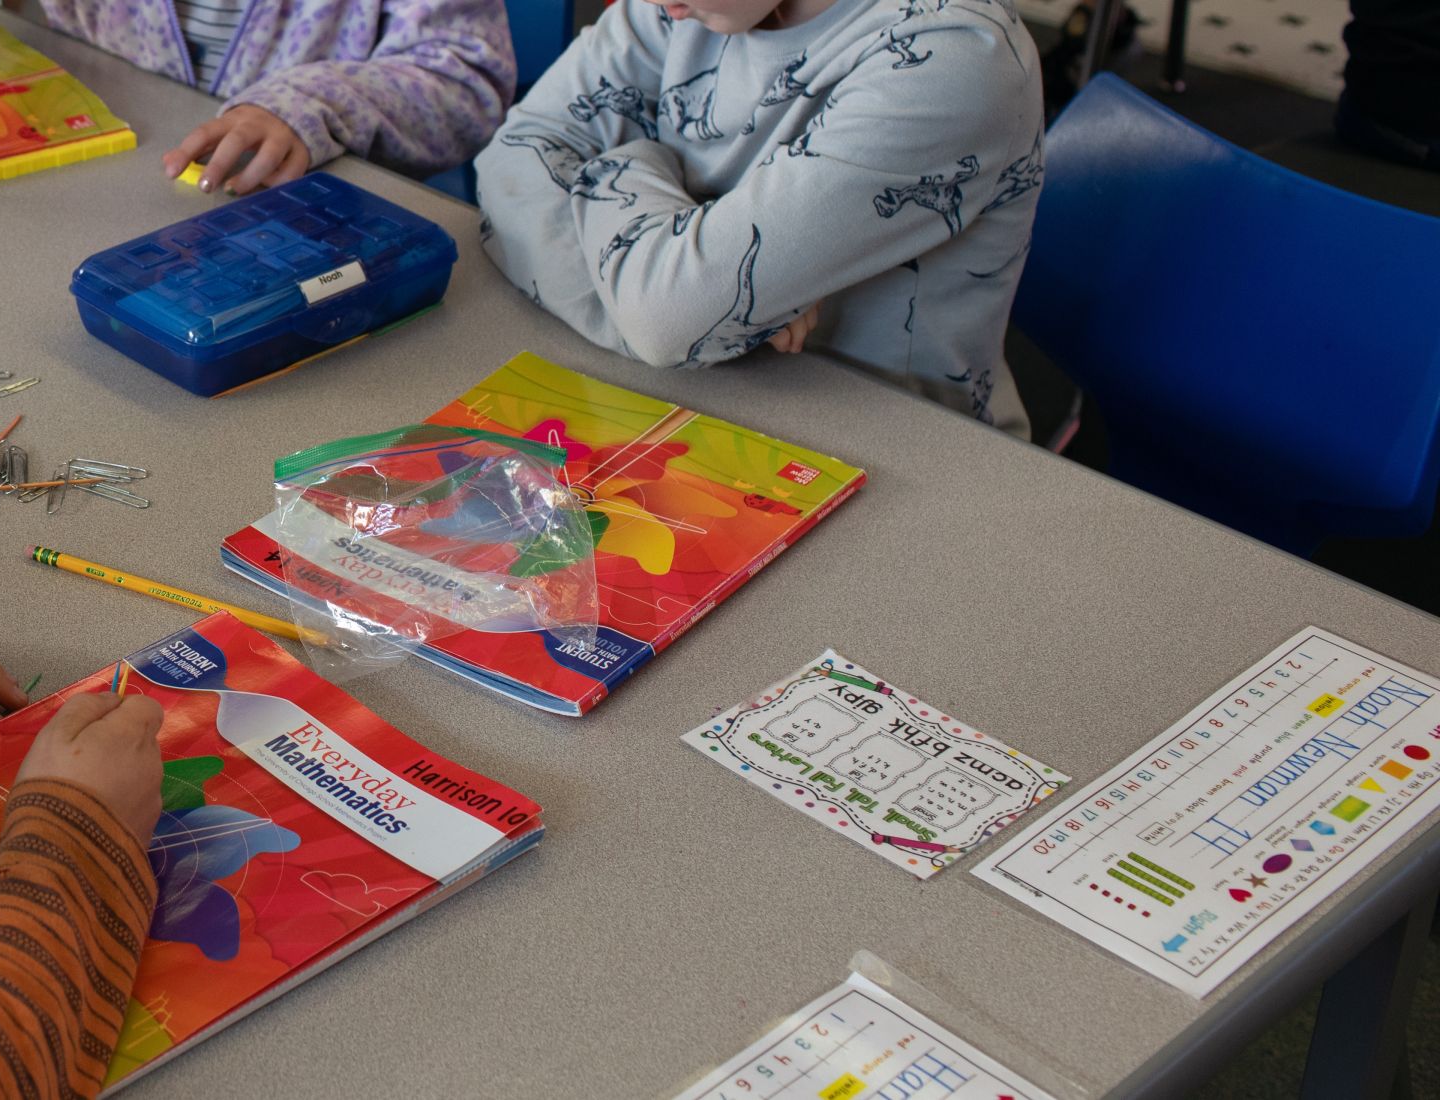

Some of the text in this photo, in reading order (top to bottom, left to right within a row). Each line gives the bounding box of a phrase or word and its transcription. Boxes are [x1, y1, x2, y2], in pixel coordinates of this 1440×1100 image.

[319, 271, 343, 285] Noah
[169, 640, 218, 672] STUDENT
[555, 643, 613, 669] STUDENT
[597, 650, 620, 661] MATH
[147, 652, 184, 680] VOLUME
[159, 647, 204, 679] MATH JOURNAL
[1285, 660, 1302, 670] 2
[1274, 669, 1291, 678] 3
[1361, 666, 1376, 678] red
[1260, 679, 1277, 688] 4
[1248, 688, 1265, 698] 5
[1234, 698, 1249, 708] 6
[1314, 696, 1336, 713] yellow
[1223, 708, 1239, 718] 7
[1208, 718, 1224, 728] 8
[1292, 713, 1313, 730] green
[782, 732, 799, 742] Fall
[889, 717, 951, 757] bfhk
[1193, 730, 1211, 739] 9
[1274, 731, 1295, 744] blue
[1179, 738, 1200, 750] 10
[1167, 748, 1184, 759] 11
[1249, 744, 1273, 764] purple
[287, 721, 417, 811] Everyday
[1151, 758, 1171, 770] 12
[1191, 679, 1431, 855] Noah Newman 14
[848, 770, 864, 780] Tall
[953, 752, 1023, 790] acmz
[1136, 769, 1157, 782] 13
[1232, 764, 1248, 779] pink
[1416, 771, 1434, 780] Gg
[264, 734, 408, 834] Mathematics
[402, 759, 502, 815] Harrison
[748, 732, 938, 843] Small, Tall, Fall Letters
[1121, 779, 1142, 792] 14
[1207, 778, 1234, 796] brown
[1408, 780, 1423, 790] Hh
[1109, 788, 1128, 801] 15
[1095, 797, 1115, 810] 16
[1185, 797, 1209, 814] black
[1385, 797, 1402, 806] Jj
[911, 806, 936, 820] Small
[1081, 808, 1100, 822] 17
[1377, 805, 1393, 815] Kk
[1064, 818, 1085, 831] 18
[1165, 812, 1184, 827] gray
[1144, 826, 1166, 842] white
[1354, 823, 1371, 835] Mm
[1049, 829, 1070, 843] 19
[1341, 835, 1356, 845] Nn
[1032, 838, 1056, 855] 20
[1328, 845, 1345, 854] Oo
[1315, 852, 1332, 864] Pp
[1299, 865, 1320, 874] Qq
[1294, 874, 1308, 883] Rr
[1280, 883, 1296, 892] Ss
[1182, 909, 1218, 935] Right
[1227, 921, 1248, 934] Ww
[1187, 956, 1205, 966] Zz
[897, 1034, 917, 1050] red
[736, 1012, 846, 1092] 1 2 3 4 5 6
